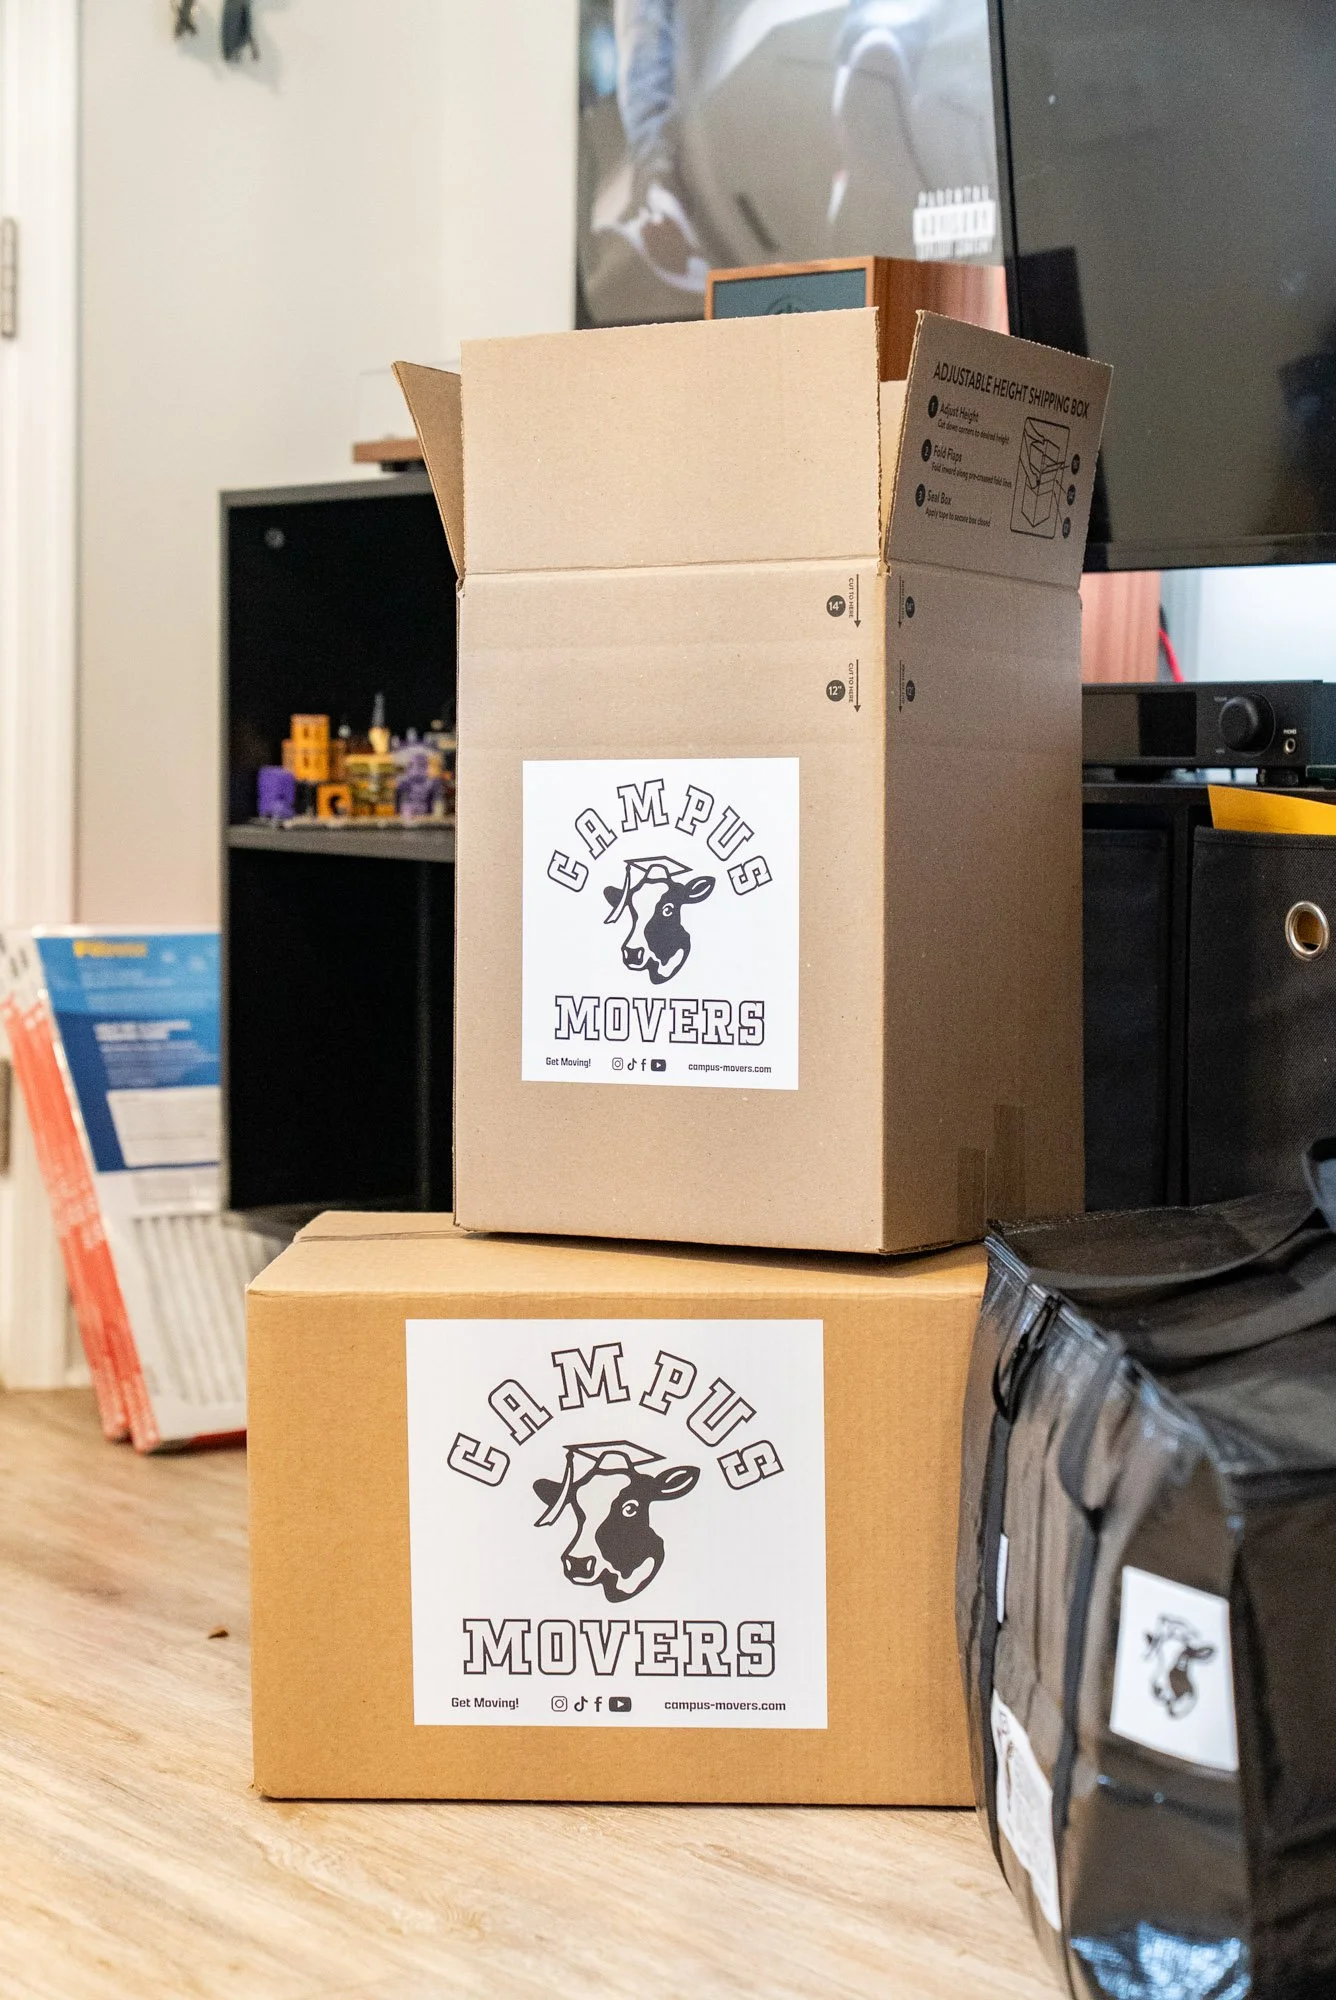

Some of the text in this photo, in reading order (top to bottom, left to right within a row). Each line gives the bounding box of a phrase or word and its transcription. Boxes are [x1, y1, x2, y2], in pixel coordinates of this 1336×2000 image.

[933, 361, 1091, 419] ADJUSTABLE HEIGHT SHIPPING BOX
[940, 403, 979, 424] Adjust Height
[934, 445, 962, 464] Fold Flaps
[927, 489, 952, 505] Seal Box
[547, 778, 773, 896] CAMPUS
[555, 995, 765, 1046] MOVERS
[545, 1057, 592, 1068] Get Moving!
[688, 1062, 772, 1074] campus-movers.com
[447, 1342, 784, 1490] CAMPUS
[463, 1618, 775, 1678] MOVERS
[451, 1697, 519, 1710] Get Moving!
[664, 1700, 786, 1713] campus-movers.com
